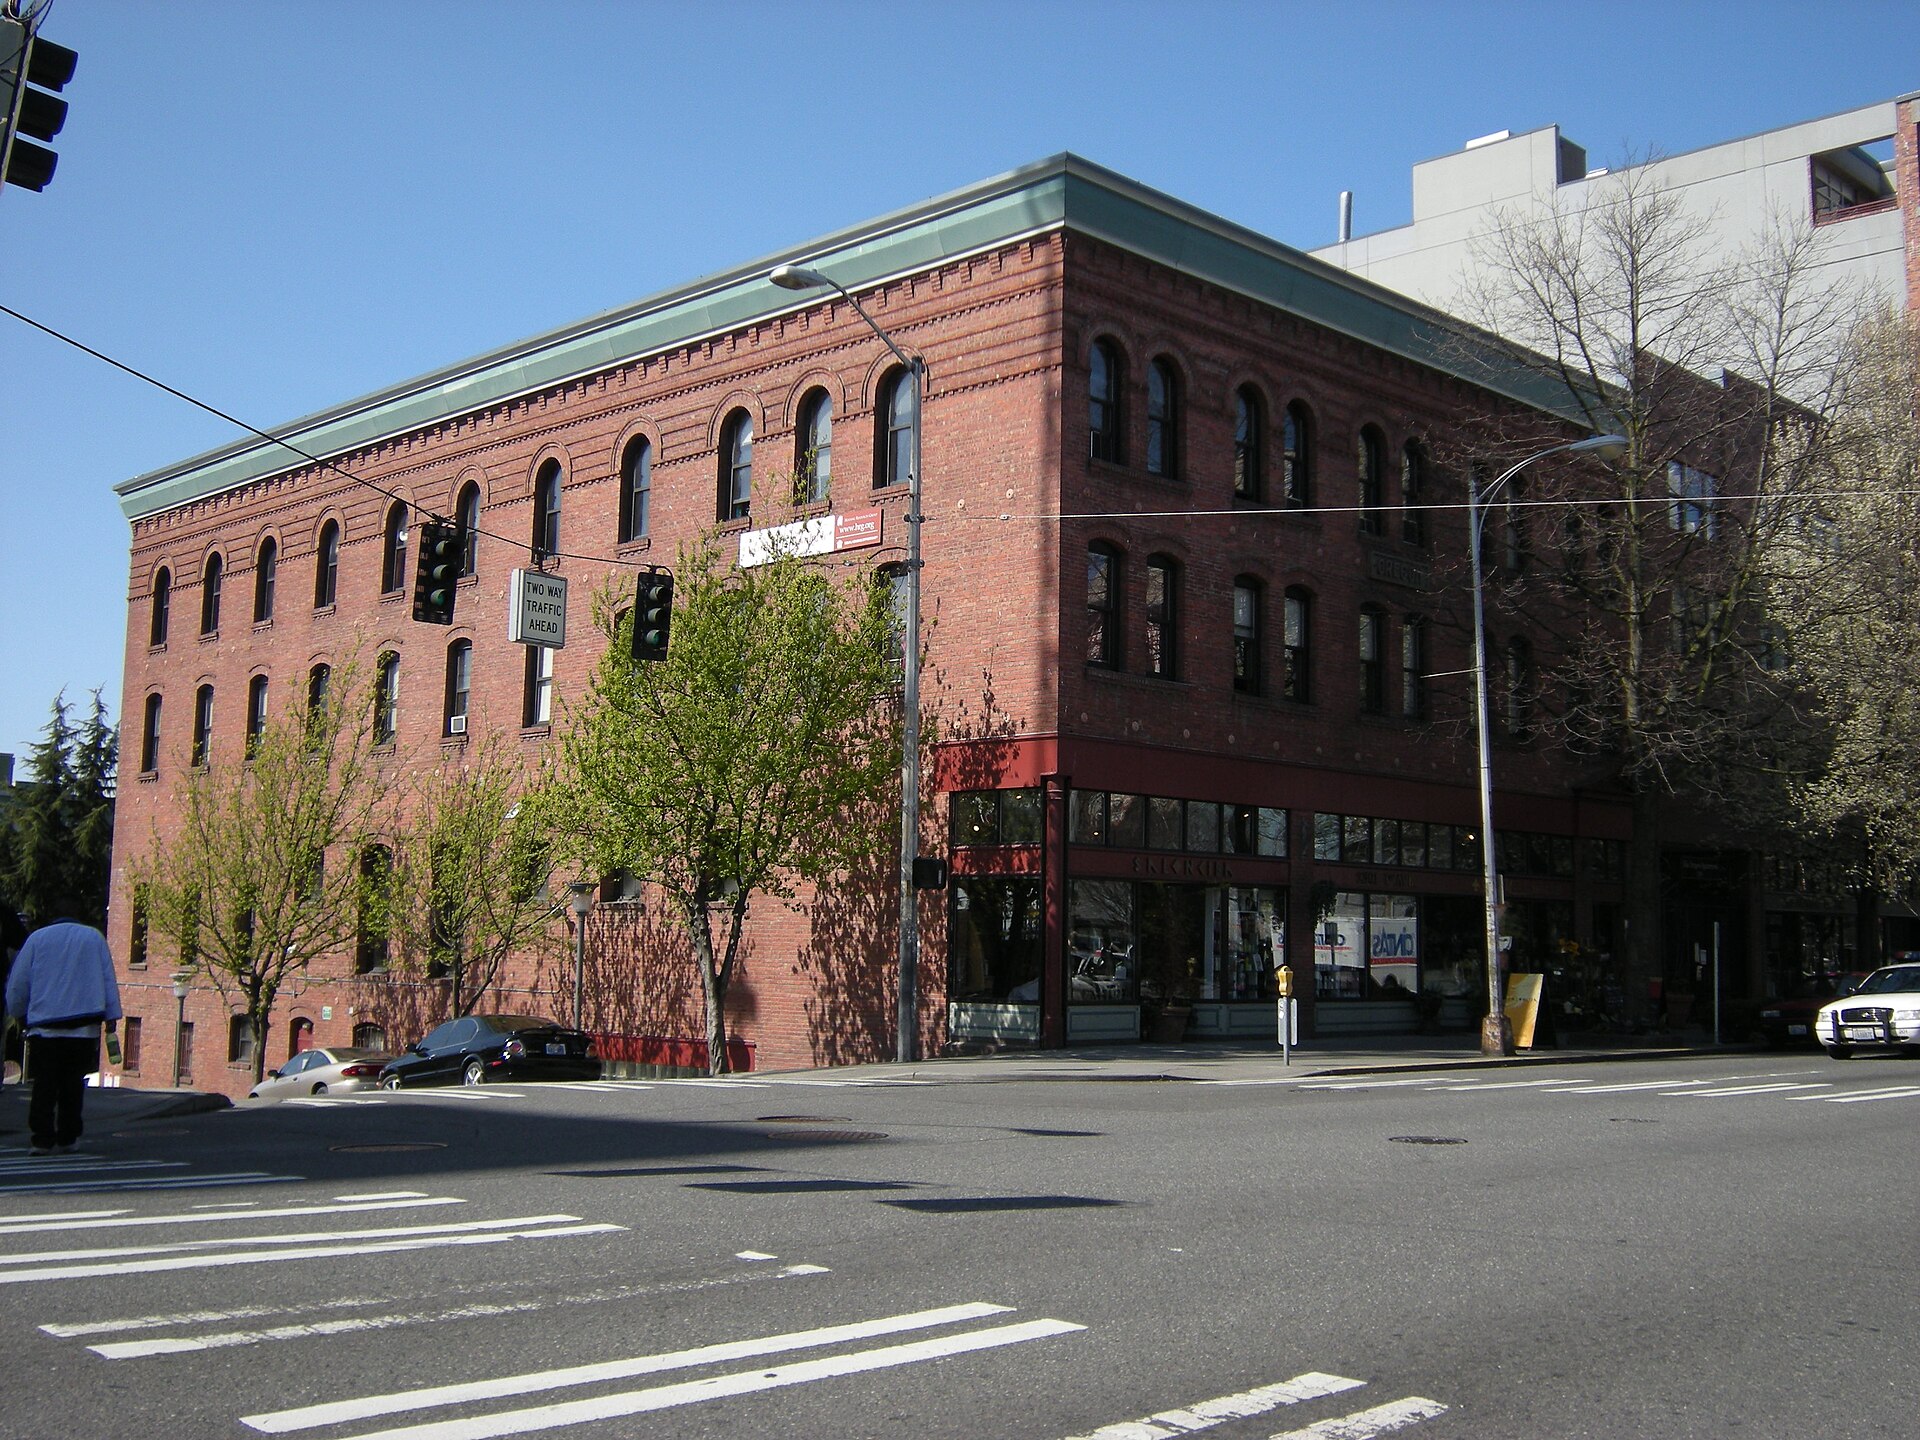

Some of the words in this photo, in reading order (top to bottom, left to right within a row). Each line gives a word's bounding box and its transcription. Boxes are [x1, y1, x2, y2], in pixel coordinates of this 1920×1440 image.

[527, 582, 544, 595] TWO
[548, 586, 563, 598] WAY
[527, 600, 561, 616] TRAFFIC
[529, 619, 557, 633] AHEAD
